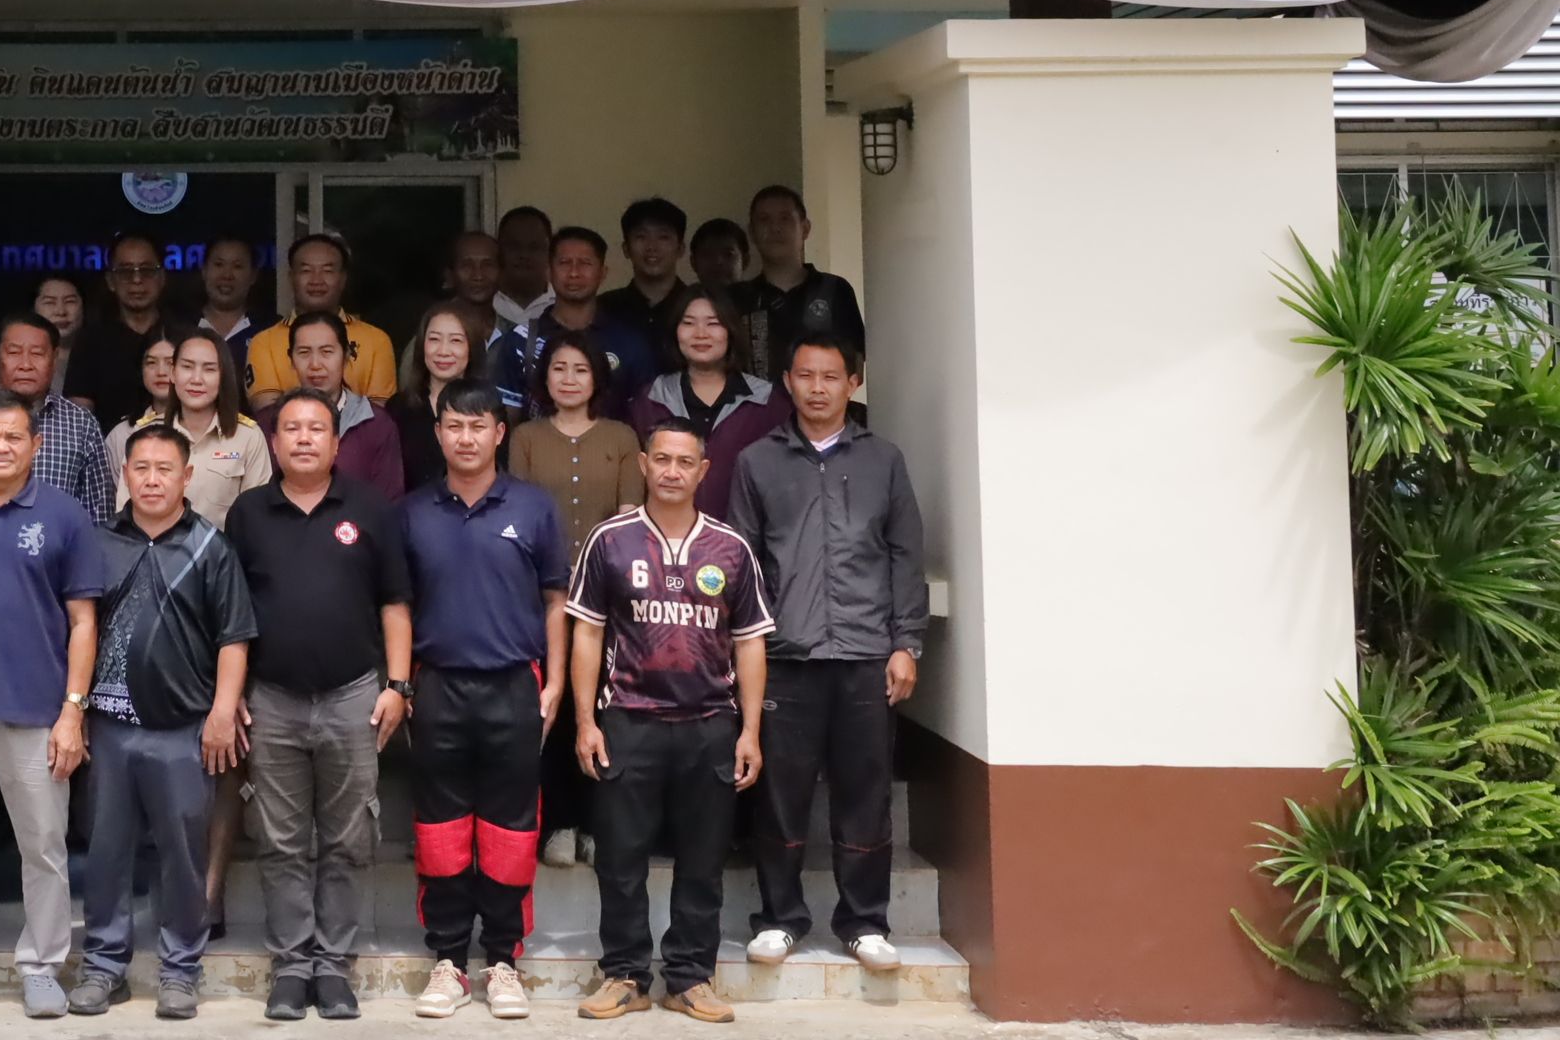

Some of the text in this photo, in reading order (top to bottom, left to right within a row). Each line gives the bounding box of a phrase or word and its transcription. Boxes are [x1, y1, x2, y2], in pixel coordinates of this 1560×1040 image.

[631, 559, 649, 589] 6
[665, 575, 685, 590] PD
[630, 599, 720, 629] MONPIN
